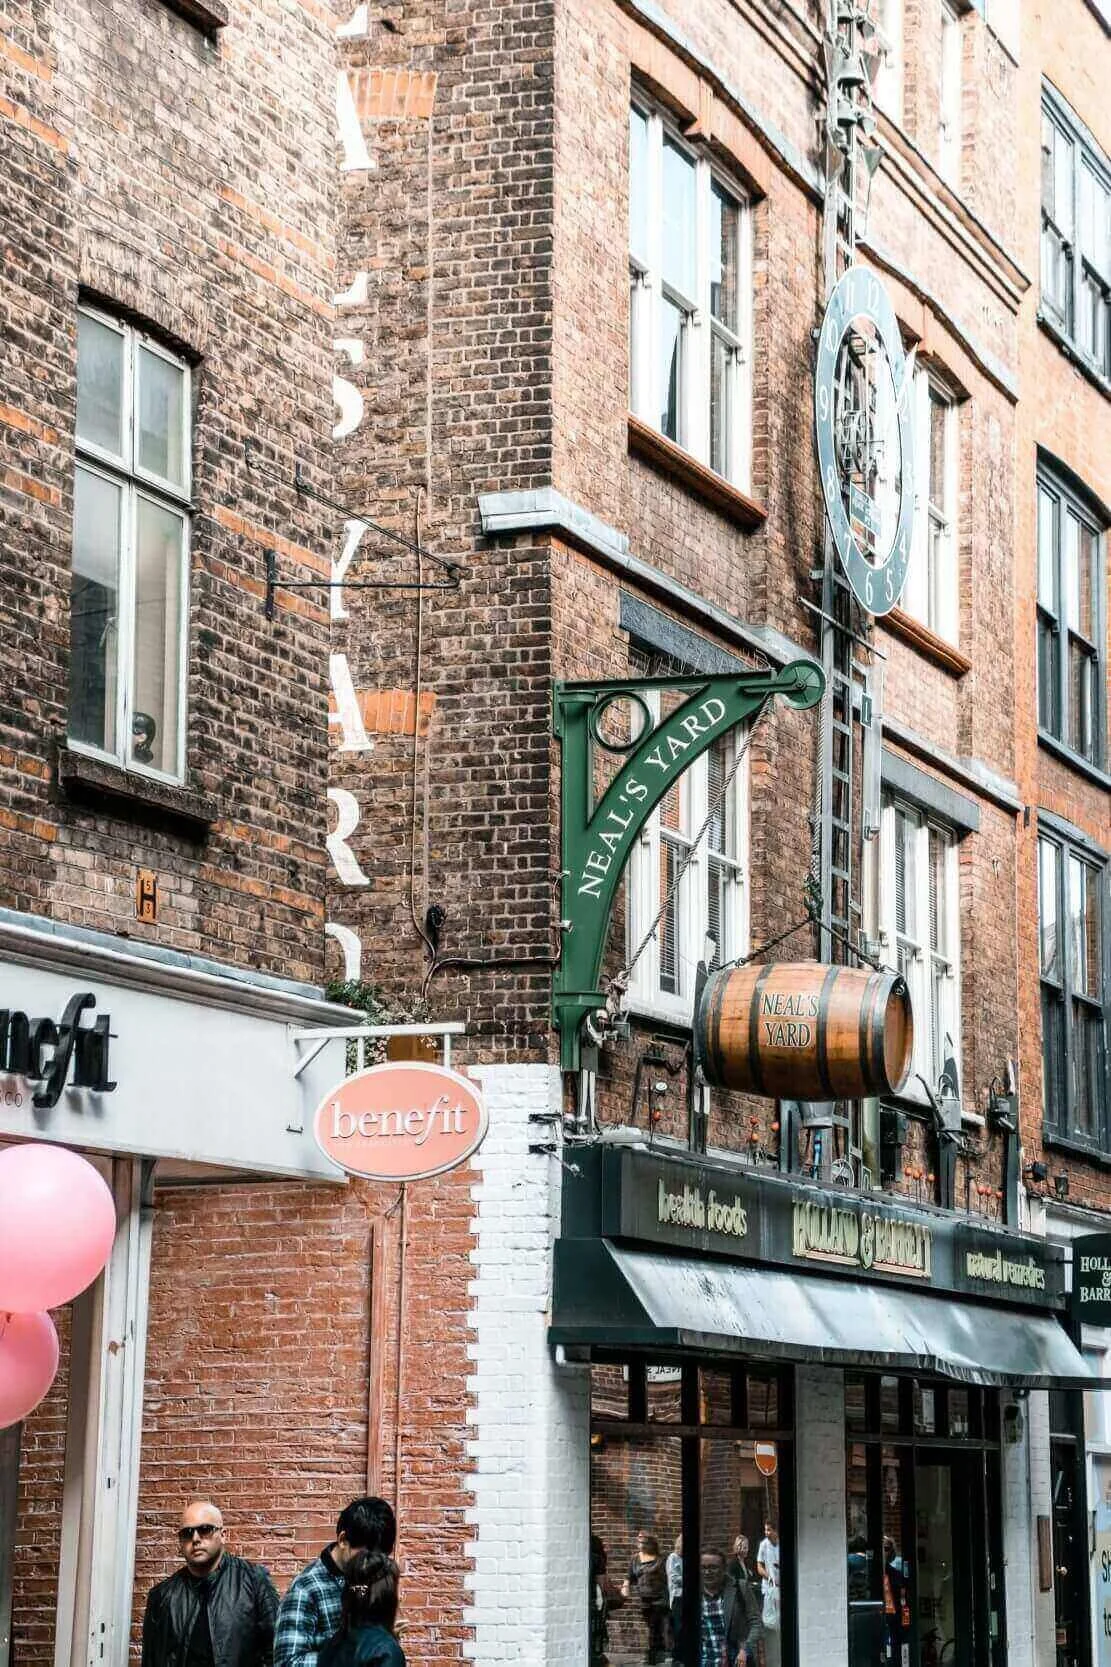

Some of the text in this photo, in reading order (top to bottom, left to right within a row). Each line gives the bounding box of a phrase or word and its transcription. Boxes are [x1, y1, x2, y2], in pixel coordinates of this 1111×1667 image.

[866, 279, 880, 316] 12
[820, 385, 828, 421] 9
[827, 465, 836, 502] 8
[844, 533, 851, 566] 7
[899, 532, 907, 564] 4
[865, 571, 873, 606] 6
[885, 568, 894, 602] 5
[578, 698, 726, 899] NEAL'S YARD
[761, 992, 819, 1017] NEAL'S
[765, 1022, 811, 1047] YARD
[330, 1095, 467, 1145] benefit
[658, 1178, 748, 1237] health foods
